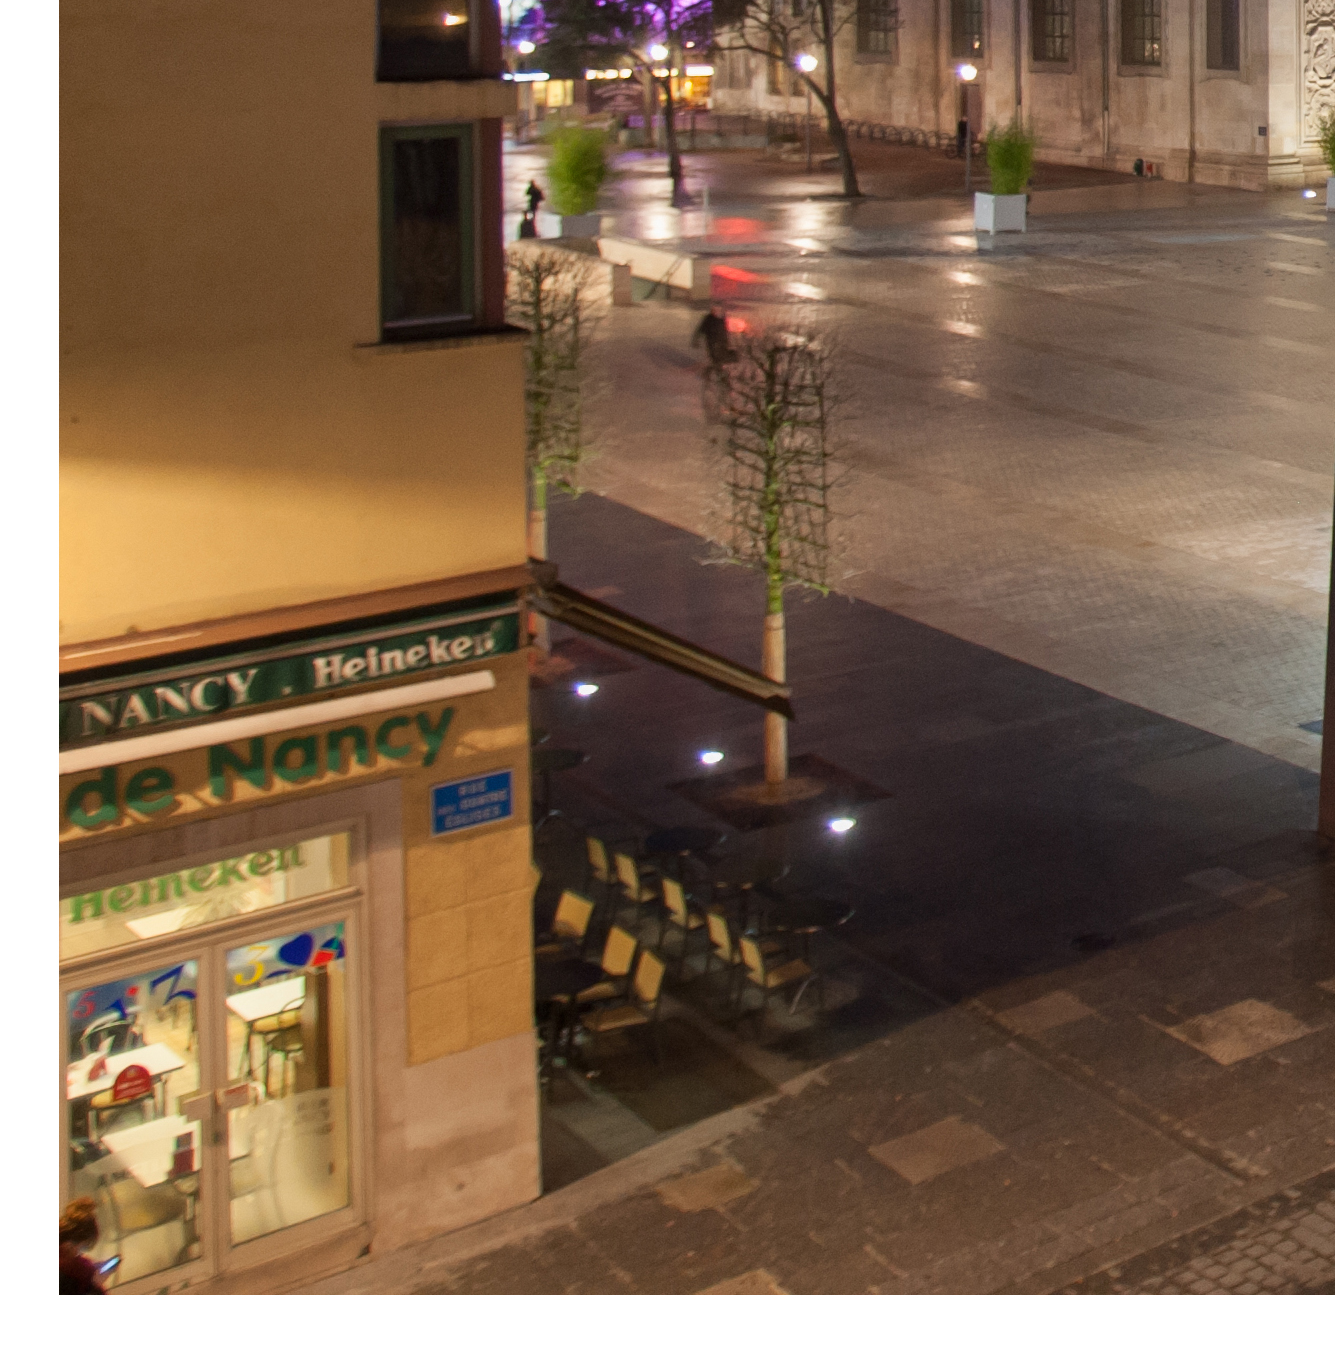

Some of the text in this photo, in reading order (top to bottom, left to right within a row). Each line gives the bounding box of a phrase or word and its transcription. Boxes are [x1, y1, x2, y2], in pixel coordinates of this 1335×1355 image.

[81, 634, 498, 737] NANCY Heineken
[67, 706, 456, 831] de Nancy
[69, 843, 306, 923] Heineken
